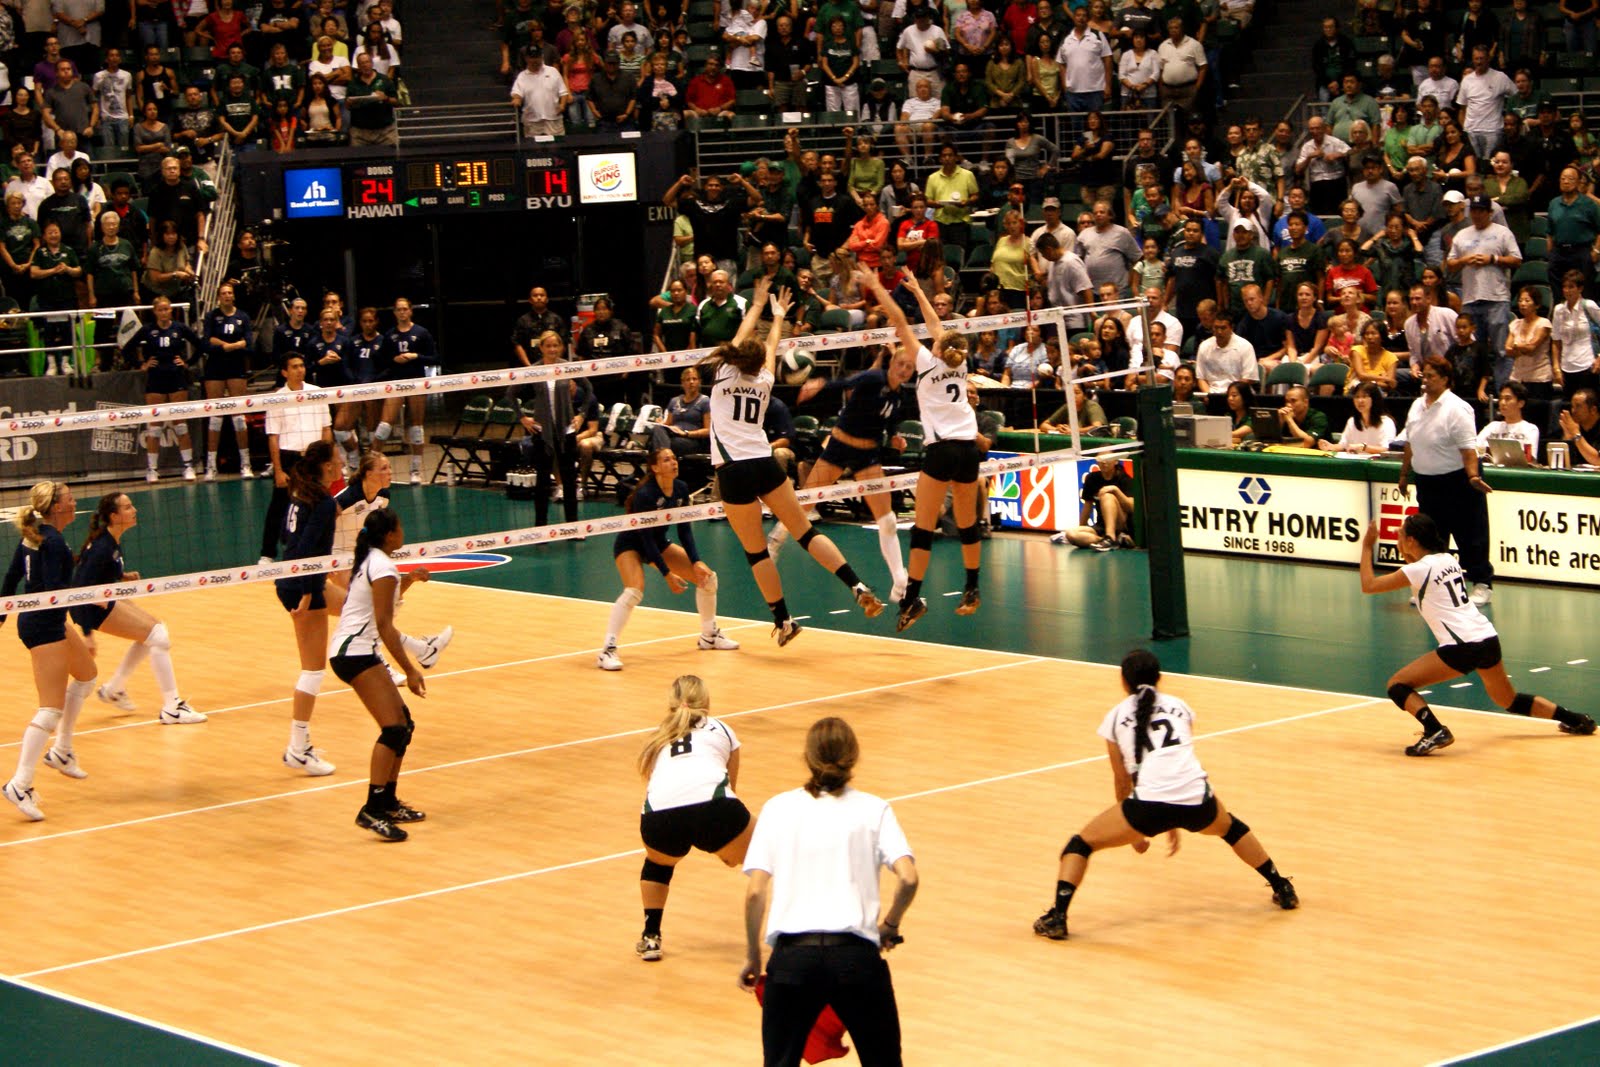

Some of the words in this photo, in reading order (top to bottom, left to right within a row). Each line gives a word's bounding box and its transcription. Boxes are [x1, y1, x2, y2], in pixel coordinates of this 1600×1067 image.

[367, 166, 393, 175] BONUS
[526, 158, 552, 168] BONUS
[594, 164, 618, 177] BURGER
[544, 170, 567, 194] 14
[595, 169, 620, 184] KING
[361, 179, 393, 203] 24
[421, 197, 438, 205] POSS
[470, 191, 480, 206] 3
[488, 193, 505, 202] POSS
[526, 195, 572, 210] BYU
[224, 323, 235, 334] 19
[160, 336, 170, 347] 18
[359, 348, 371, 358] 21
[72, 415, 99, 425] pepsi
[169, 405, 196, 416] pepsi
[262, 396, 288, 406] pepsi
[352, 386, 378, 397] pepsi
[439, 377, 464, 388] pepsi
[523, 369, 547, 379] pepsi
[605, 360, 628, 369] pepsi
[946, 383, 960, 403] 2
[732, 394, 761, 424] 10
[95, 439, 133, 452] GUARD
[1179, 505, 1259, 534] ENTRY
[1268, 512, 1360, 543] HOMES
[1518, 509, 1568, 534] 106.5
[1223, 536, 1260, 551] SINCE
[1265, 541, 1295, 554] 1968
[1500, 541, 1517, 563] in
[1526, 544, 1560, 567] the
[68, 591, 96, 603] pepsi
[164, 579, 191, 590] pepsi
[257, 567, 284, 579] pepsi
[434, 543, 459, 554] pepsi
[518, 532, 543, 543] pepsi
[600, 520, 623, 531] pepsi
[679, 508, 702, 519] pepsi
[1443, 576, 1469, 608] 13
[670, 732, 692, 758] 8
